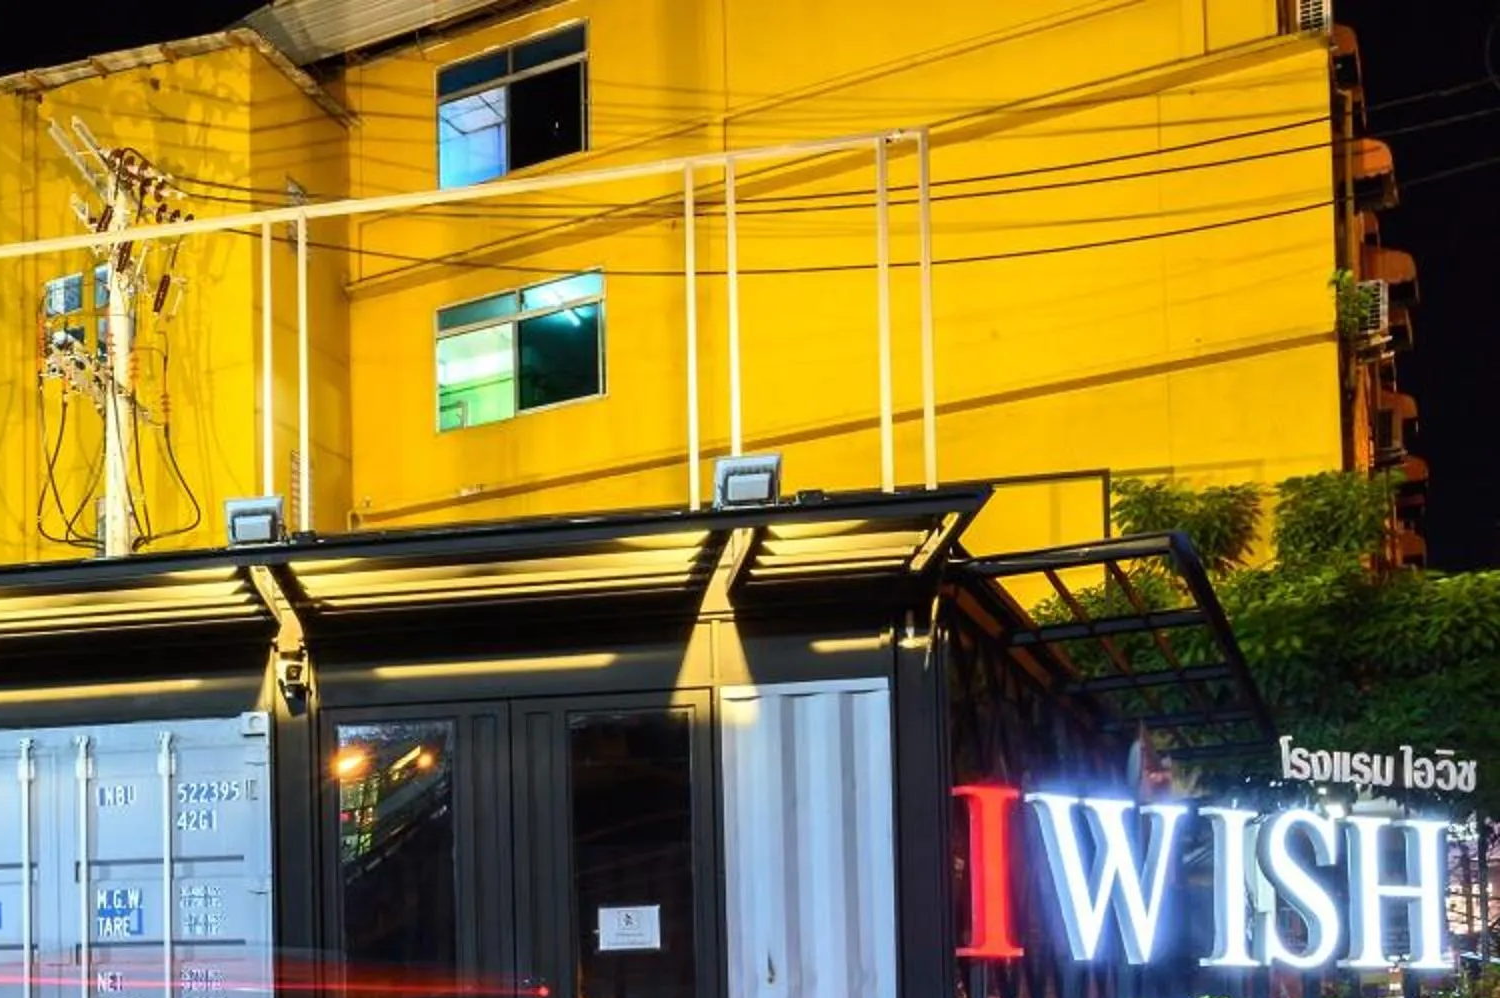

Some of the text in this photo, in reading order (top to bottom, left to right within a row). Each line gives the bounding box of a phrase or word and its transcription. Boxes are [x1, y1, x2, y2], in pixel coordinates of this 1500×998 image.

[1279, 735, 1477, 792] โรงแรม ไอวิช
[98, 916, 132, 938] TARE
[97, 971, 123, 992] NET
